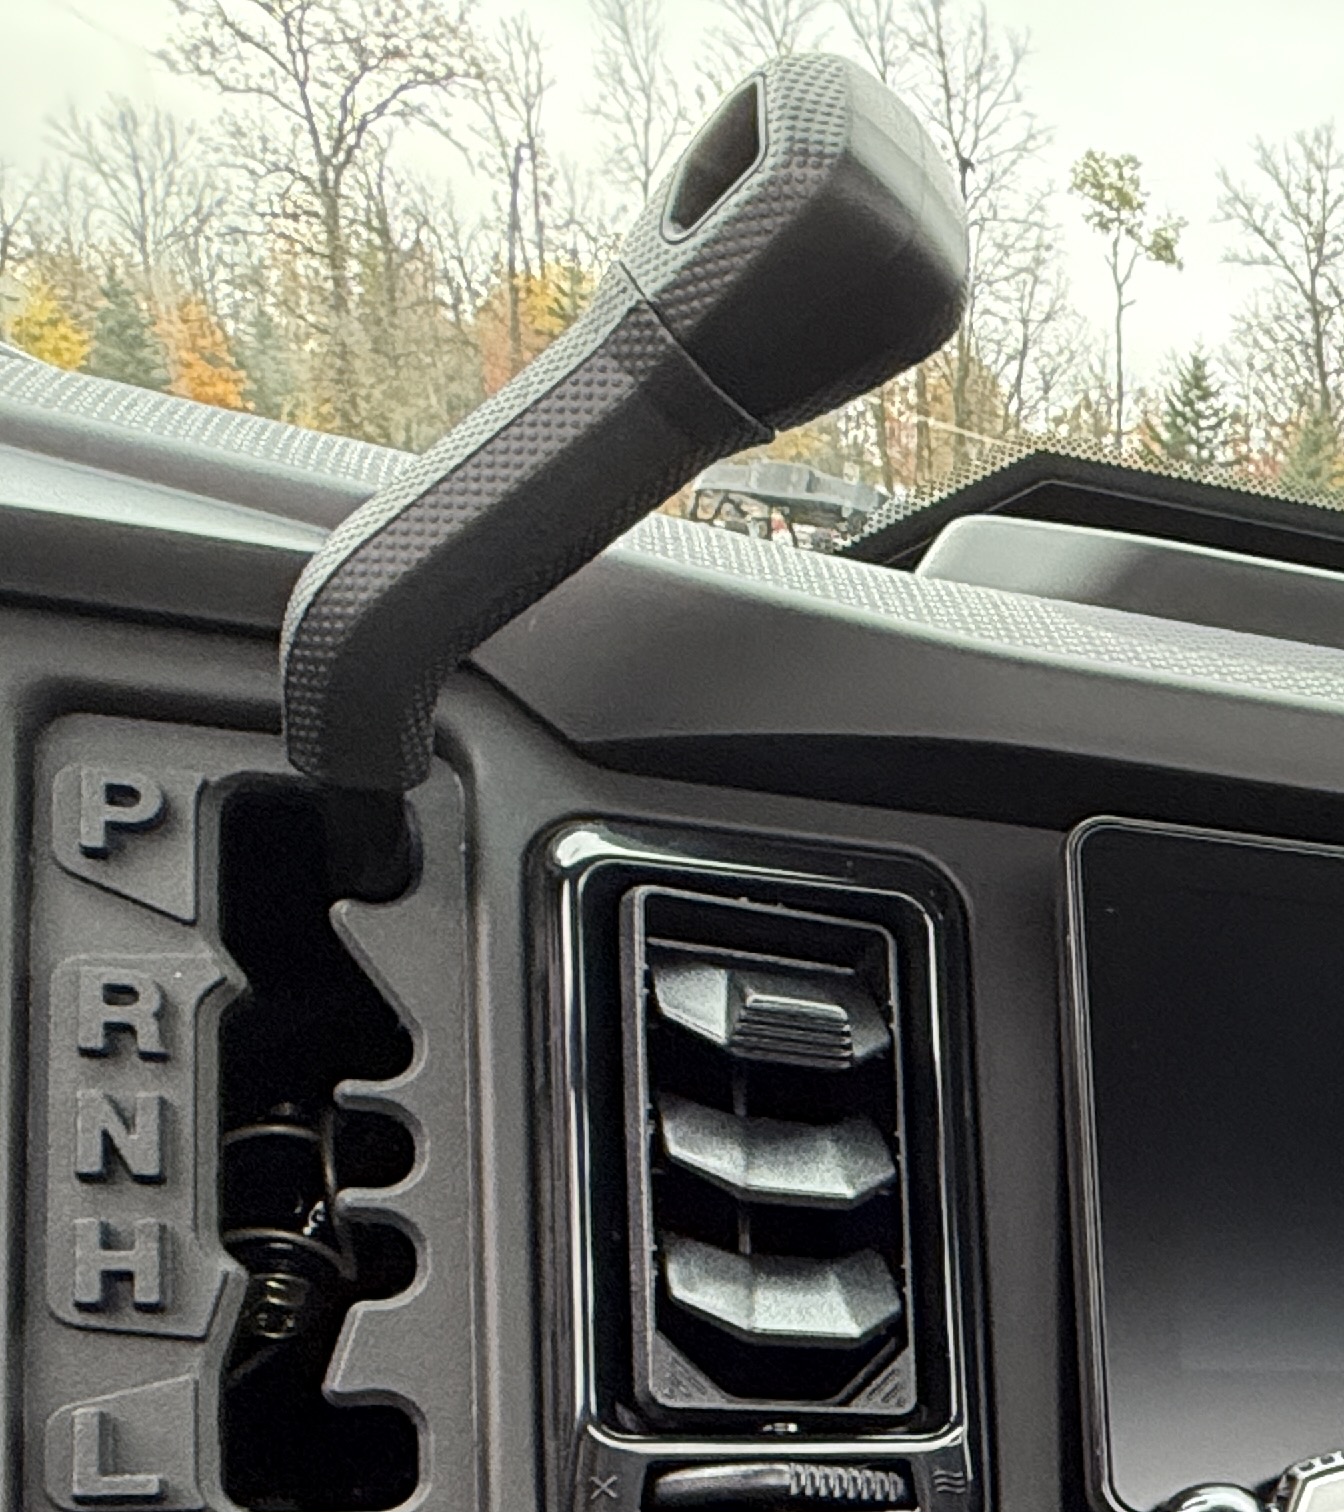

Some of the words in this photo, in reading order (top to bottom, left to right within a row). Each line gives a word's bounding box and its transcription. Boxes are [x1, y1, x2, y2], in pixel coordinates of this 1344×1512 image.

[78, 766, 167, 857] P
[76, 966, 170, 1060] R
[74, 1089, 167, 1185] N
[73, 1218, 166, 1313] H
[71, 1408, 164, 1505] L
